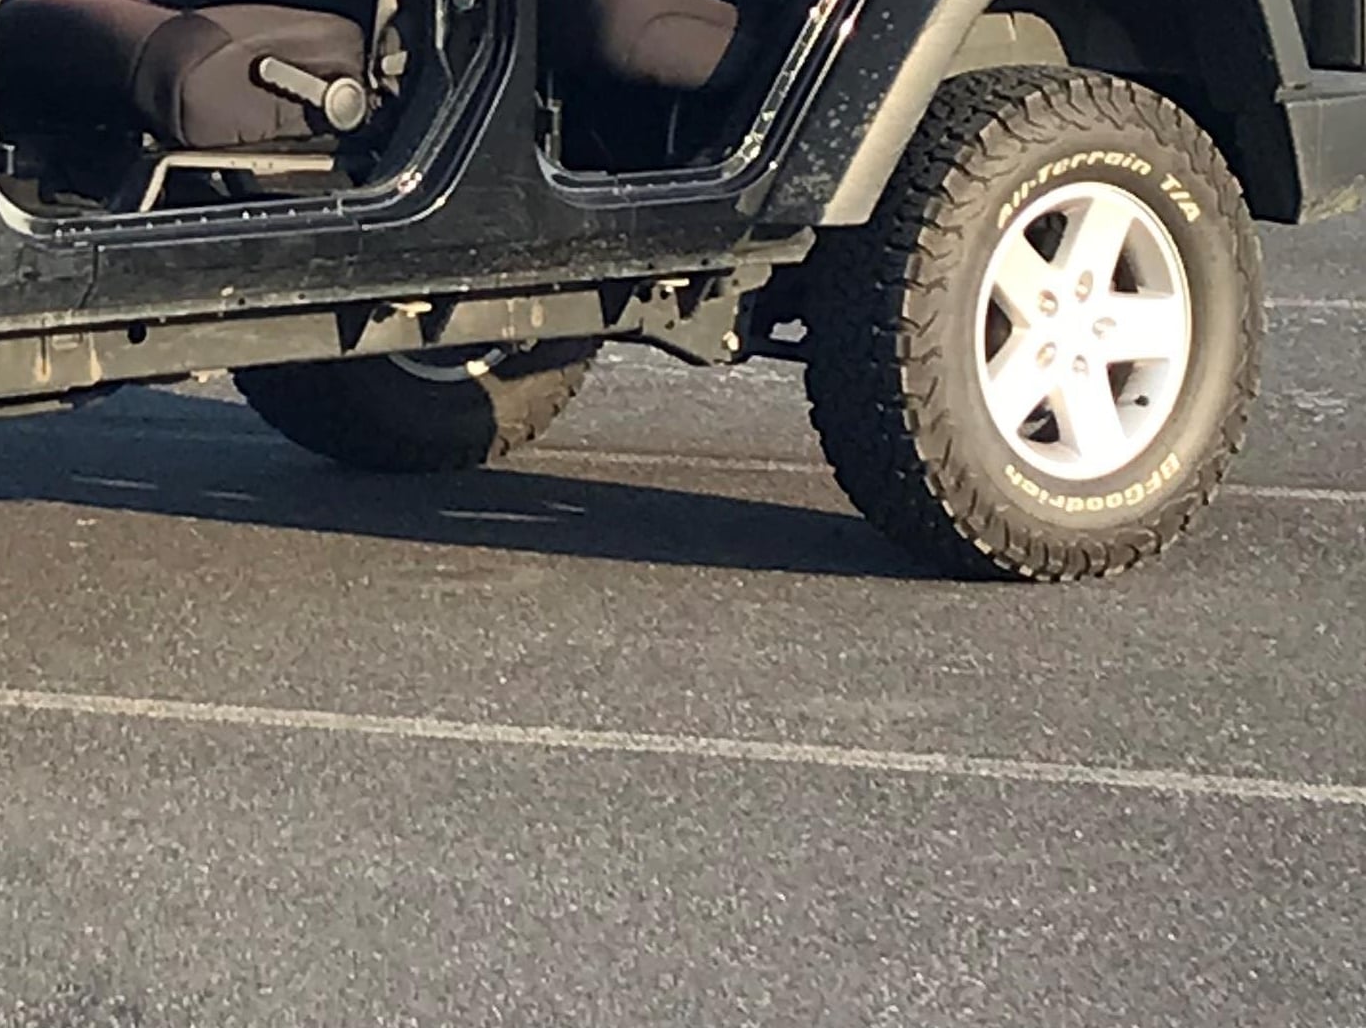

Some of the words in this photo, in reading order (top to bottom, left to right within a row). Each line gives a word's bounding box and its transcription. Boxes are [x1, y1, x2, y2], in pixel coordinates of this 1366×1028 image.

[998, 151, 1152, 229] All-Terrain
[1160, 173, 1201, 222] T/A
[1005, 452, 1181, 512] BFGoodrich
